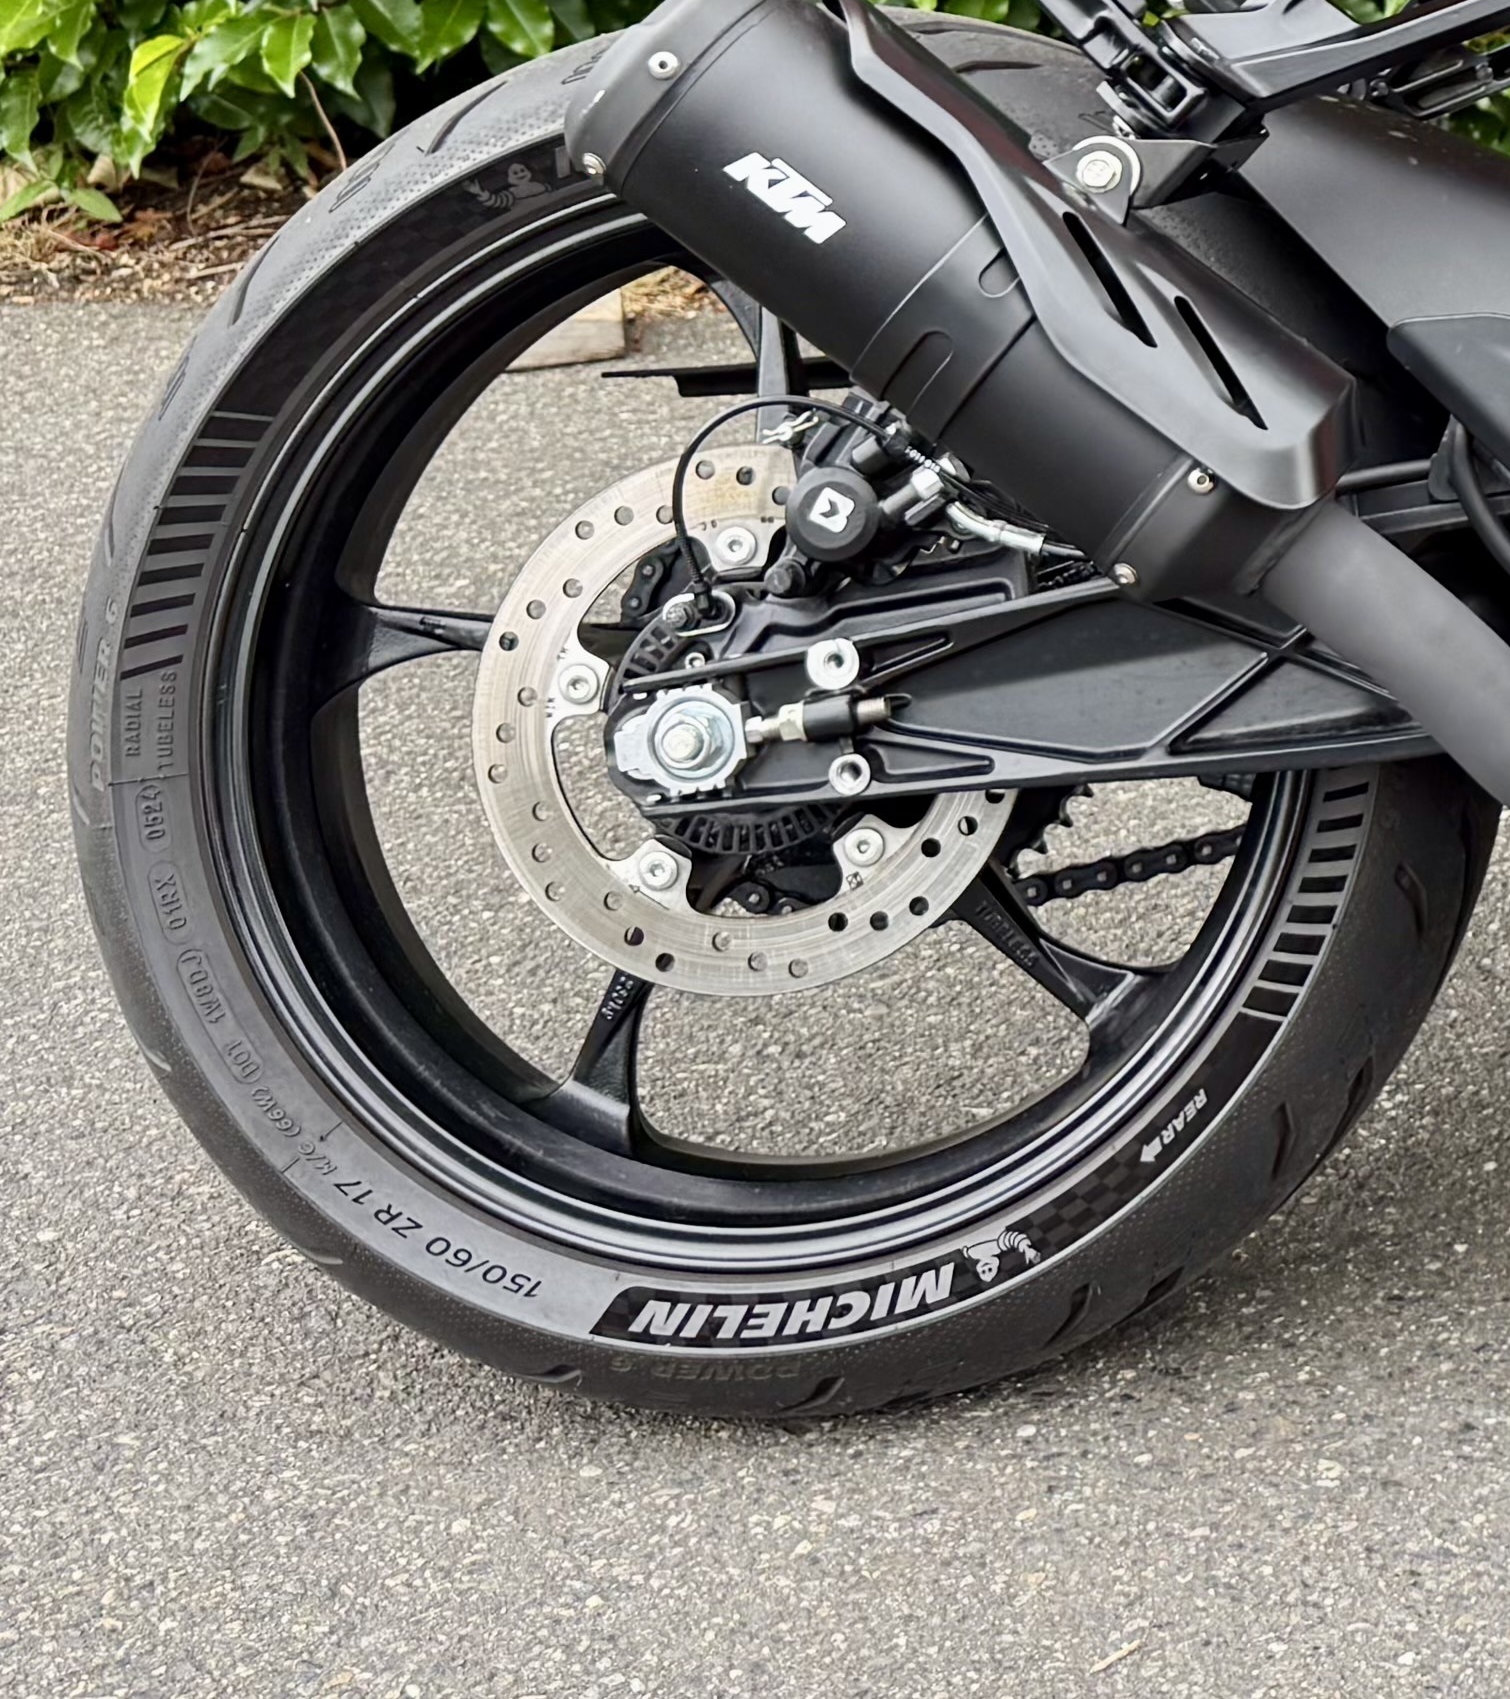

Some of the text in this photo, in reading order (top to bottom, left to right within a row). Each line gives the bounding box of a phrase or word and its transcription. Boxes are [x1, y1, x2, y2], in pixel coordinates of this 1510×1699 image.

[723, 151, 846, 245] KTM
[89, 635, 114, 793] POWER
[124, 686, 144, 757] RADIAL
[155, 670, 179, 771] TUBELESS
[142, 786, 166, 841] 0524
[223, 1037, 261, 1078] DOT
[251, 1085, 303, 1139] (66W)
[1160, 1088, 1208, 1145] REAR
[333, 1180, 374, 1205] 17
[373, 1203, 424, 1239] ZR
[425, 1236, 542, 1298] 150/60
[628, 1261, 955, 1340] MICHELIN
[609, 1354, 801, 1382] POWER 6
